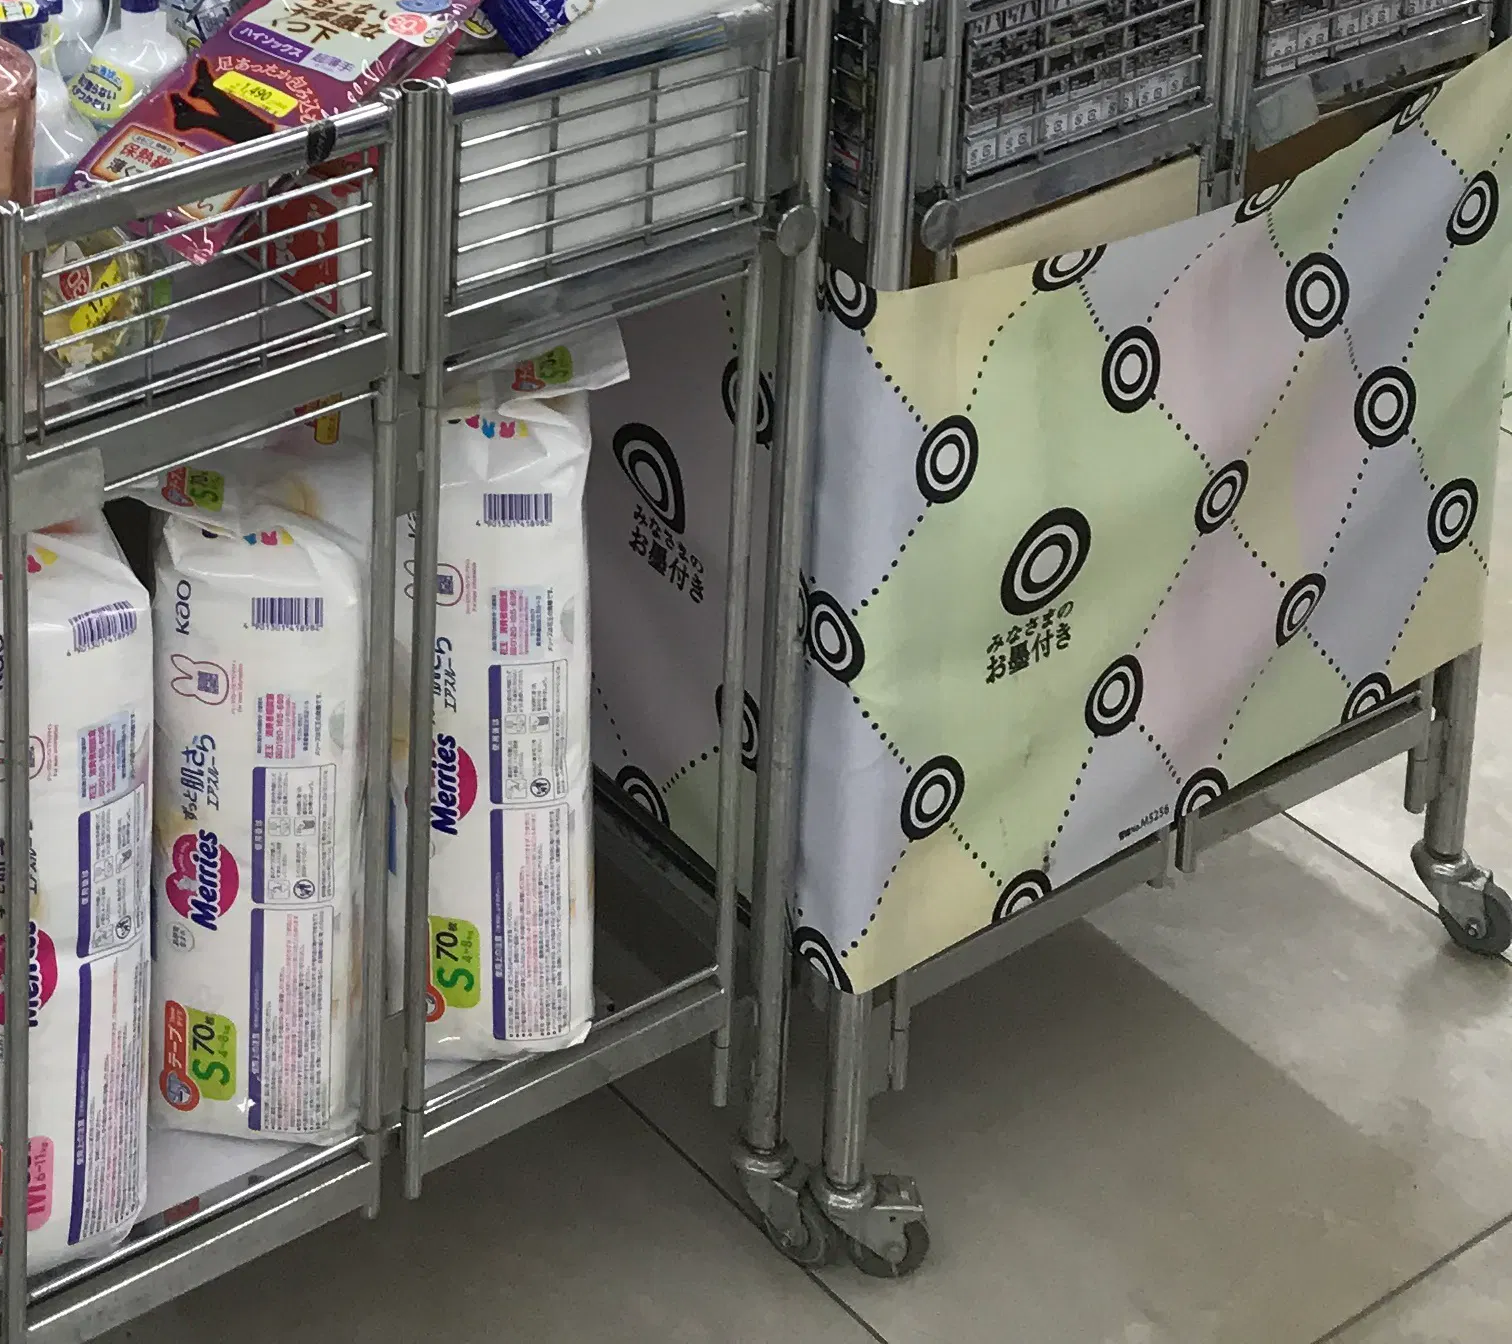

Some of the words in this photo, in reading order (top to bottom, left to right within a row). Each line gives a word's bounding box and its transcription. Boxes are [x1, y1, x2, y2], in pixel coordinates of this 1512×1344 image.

[240, 26, 305, 57] ハイソックス
[986, 622, 1072, 684] お墨付き
[987, 600, 1074, 654] みなさまの
[430, 732, 459, 837] Merries
[190, 828, 219, 932] Merries
[435, 967, 476, 995] S
[171, 1019, 186, 1070] テープ
[192, 1056, 231, 1087] S
